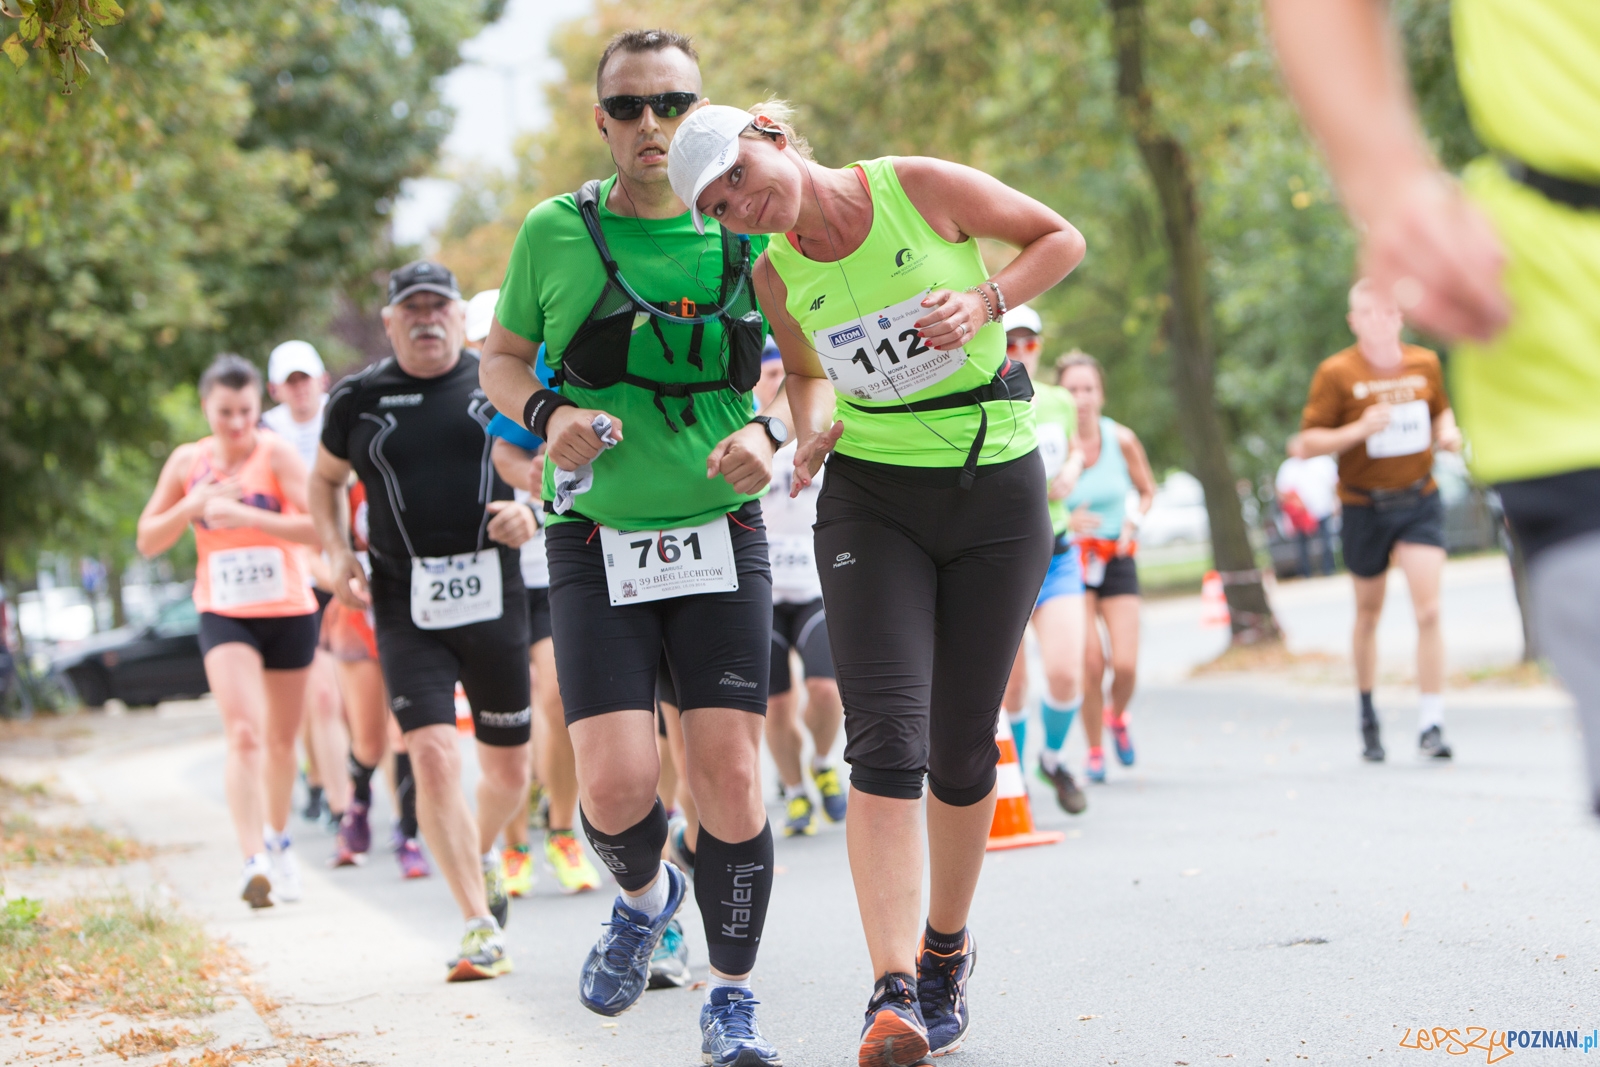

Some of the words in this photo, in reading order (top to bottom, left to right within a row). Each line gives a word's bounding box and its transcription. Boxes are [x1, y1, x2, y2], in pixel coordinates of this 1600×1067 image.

[852, 328, 930, 375] 112
[867, 381, 880, 391] 39
[881, 373, 904, 387] BEG
[905, 351, 951, 378] LECHITÓW
[887, 364, 908, 375] MONIKA
[630, 532, 702, 569] 761
[430, 575, 481, 601] 269
[639, 578, 651, 586] 39
[653, 572, 676, 584] BIEG
[678, 566, 723, 580] LECHITÓW
[718, 677, 759, 689] Rogelli
[720, 861, 765, 939] Kalenji
